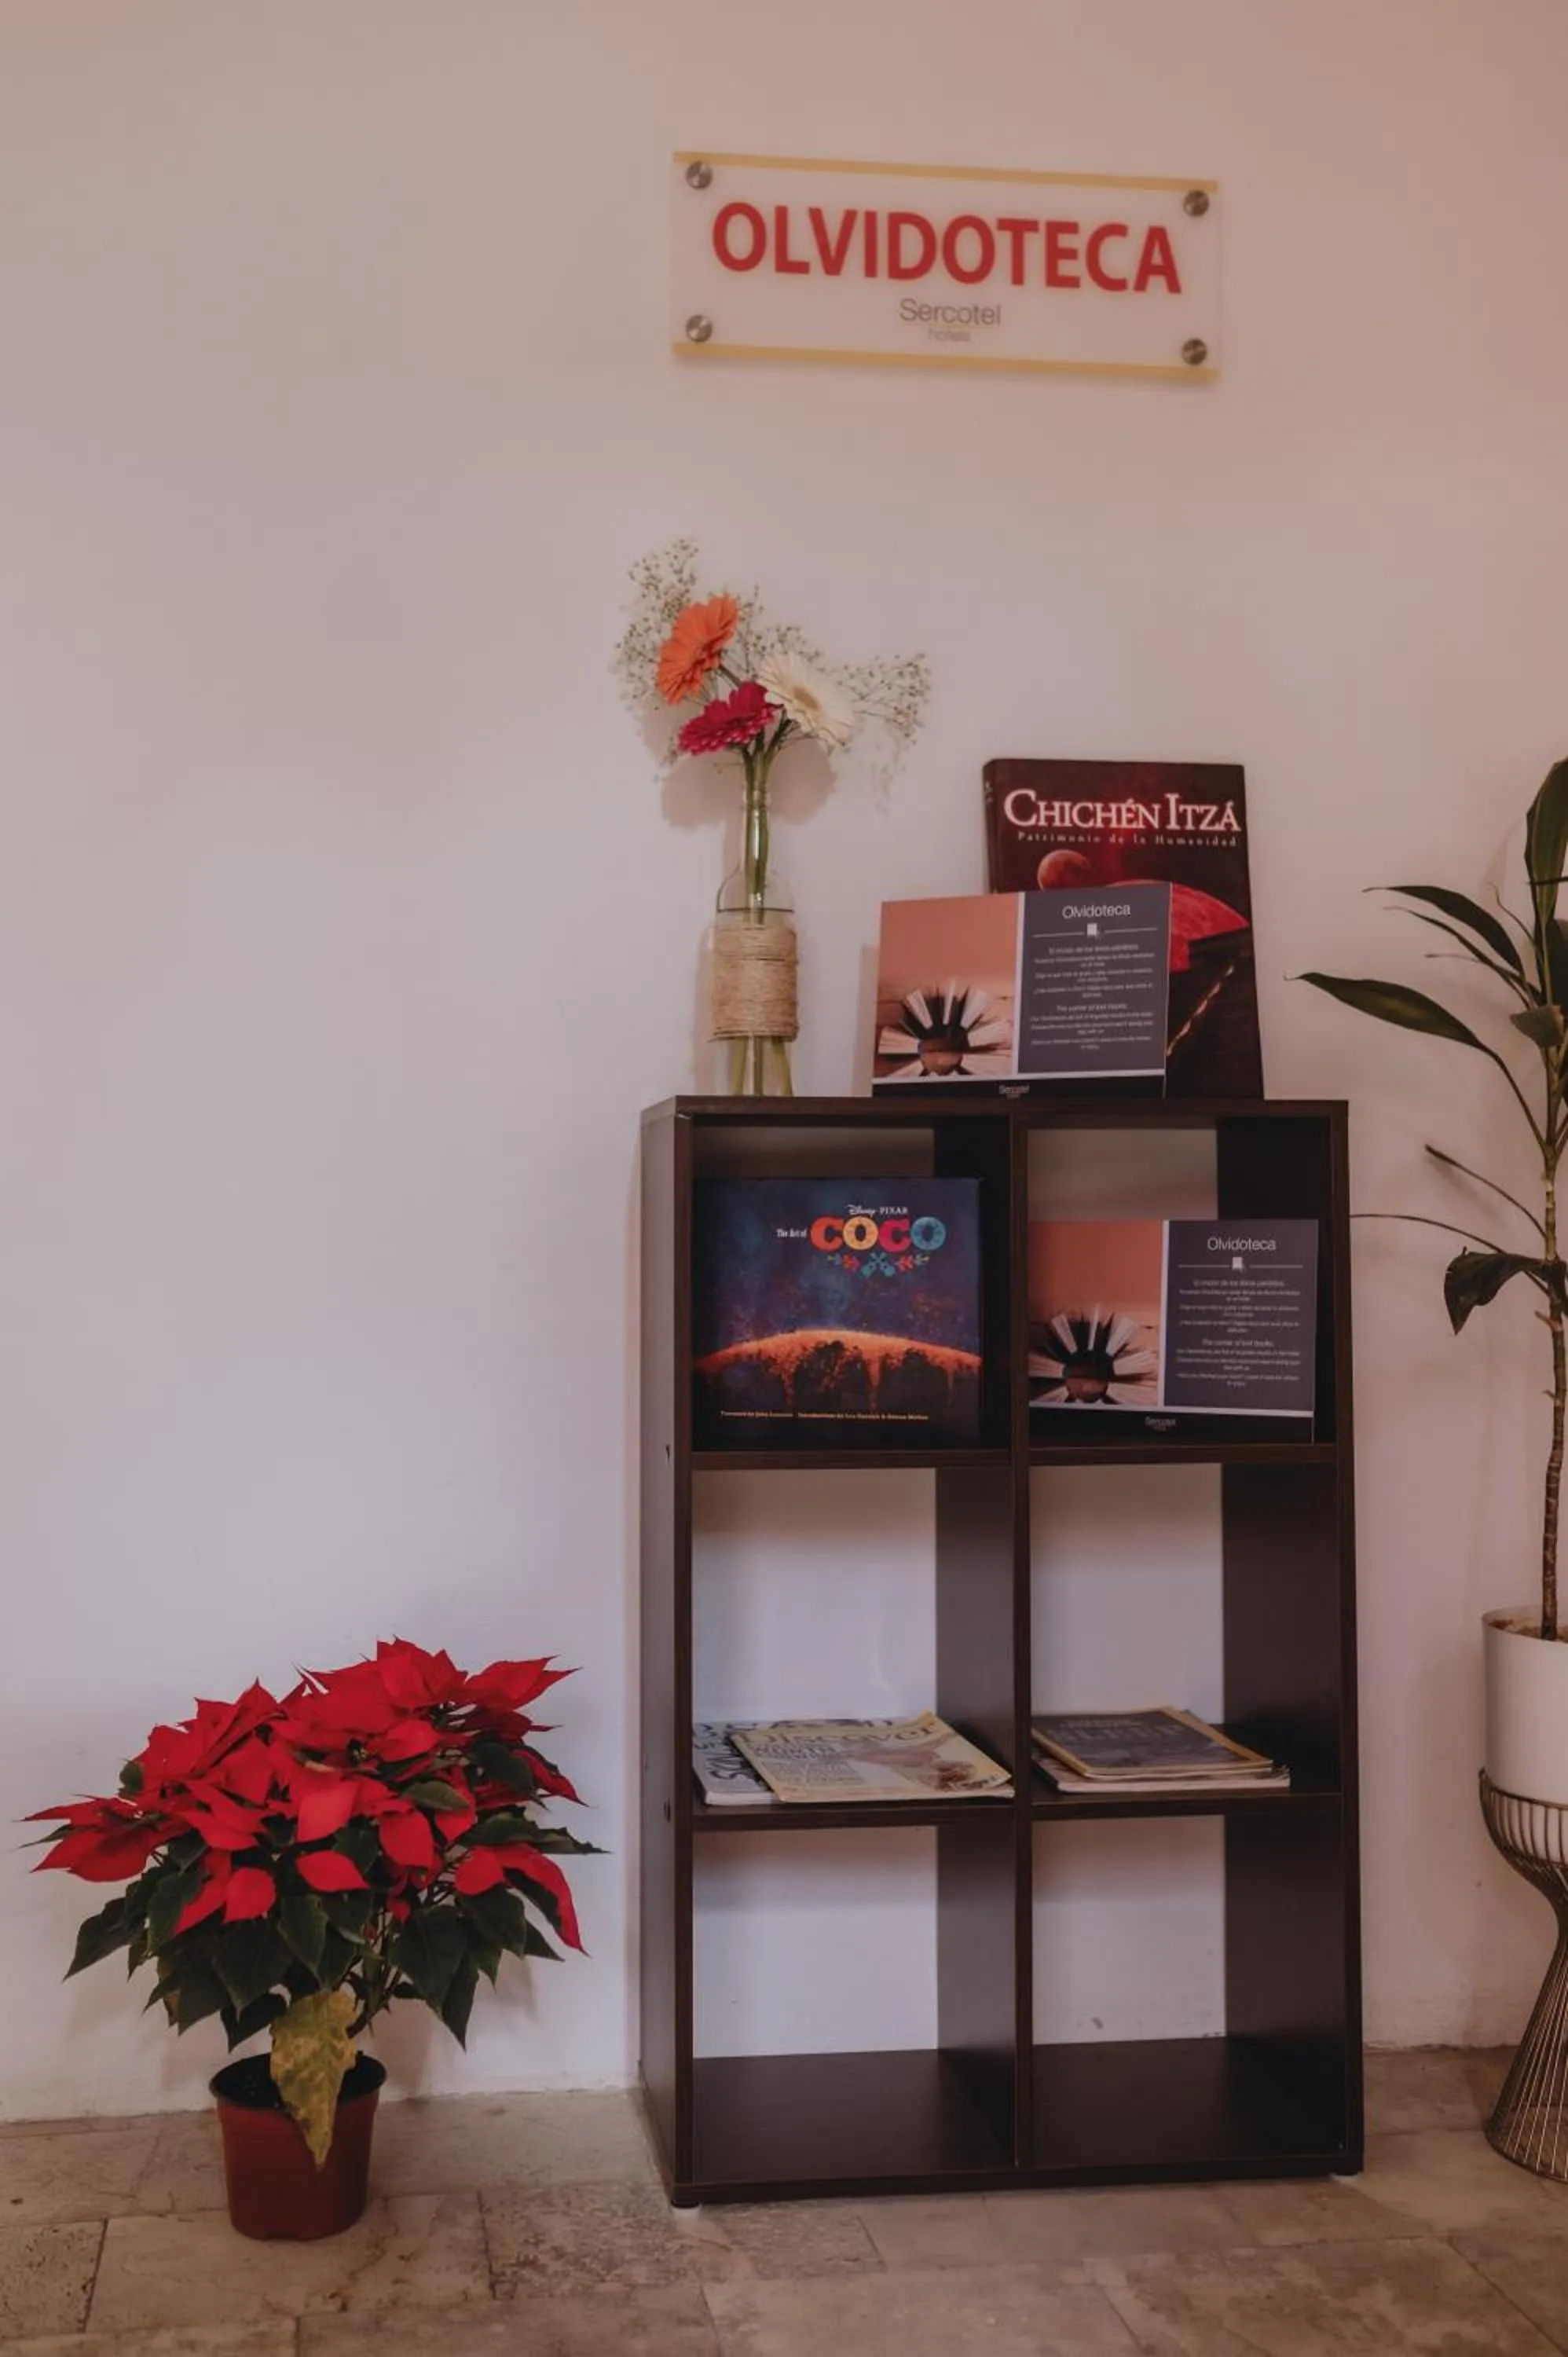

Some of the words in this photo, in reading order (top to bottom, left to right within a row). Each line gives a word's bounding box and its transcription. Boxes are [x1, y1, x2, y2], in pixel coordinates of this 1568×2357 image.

[712, 201, 1182, 294] OLVIDOTECA
[899, 298, 1001, 326] Sercotel
[1004, 788, 1161, 830] CHICHÉN
[1164, 793, 1241, 832] ITZÁ
[1017, 831, 1101, 843] Patrimonio
[1108, 833, 1124, 844] de
[1133, 834, 1146, 845] la
[1156, 835, 1237, 848] Humanidad
[1062, 904, 1131, 919] Olvidoteca
[879, 1206, 908, 1215] PIXAR
[810, 1215, 947, 1252] COCO
[1207, 1236, 1277, 1251] Olvidoteca
